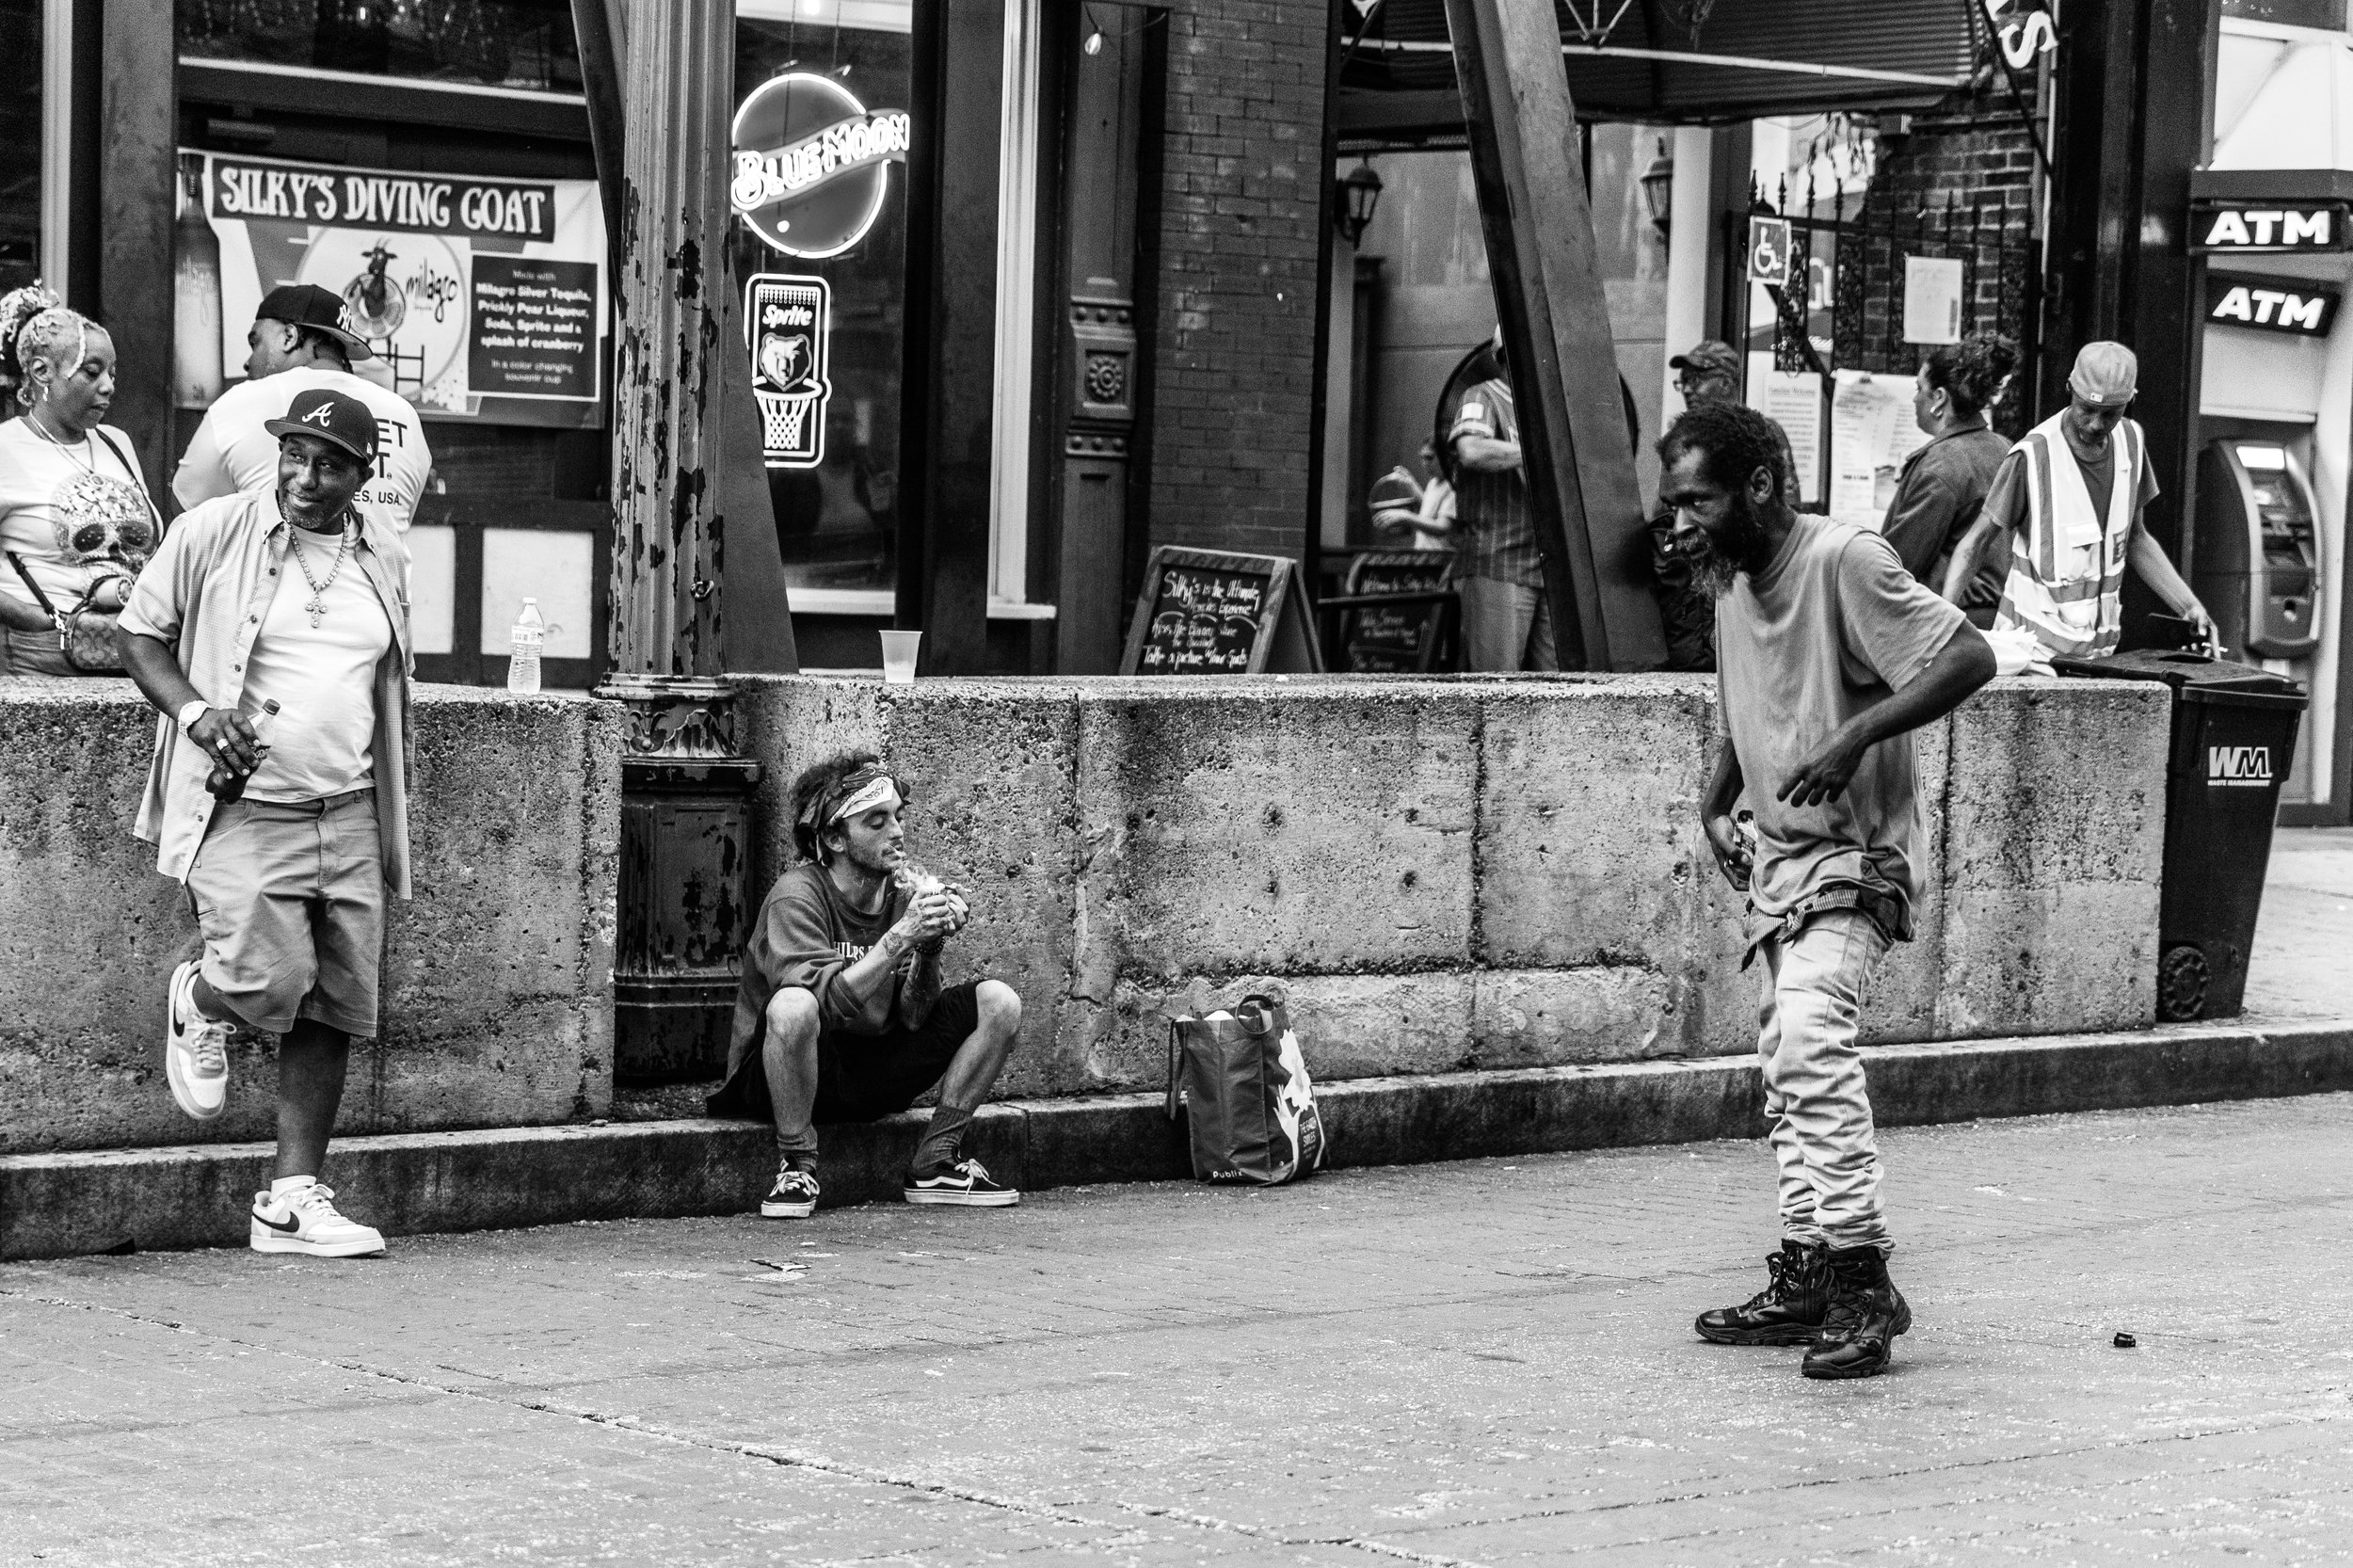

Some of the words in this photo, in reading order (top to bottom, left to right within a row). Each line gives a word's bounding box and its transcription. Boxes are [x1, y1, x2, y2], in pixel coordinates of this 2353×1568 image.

[220, 167, 337, 221] SILKY'S
[344, 177, 452, 228] DIVING
[460, 187, 545, 234] GOAT
[2204, 210, 2330, 245] ATM
[517, 284, 549, 298] Silver
[516, 301, 544, 315] Pear
[761, 303, 813, 328] Sprite
[2212, 286, 2326, 329] ATM
[516, 318, 550, 333] Sprite
[552, 321, 574, 334] and
[480, 334, 515, 348] splash
[516, 335, 530, 348] of
[530, 337, 584, 354] cranberry
[301, 402, 335, 427] A
[2209, 746, 2273, 778] WM
[1212, 1169, 1243, 1178] Publix
